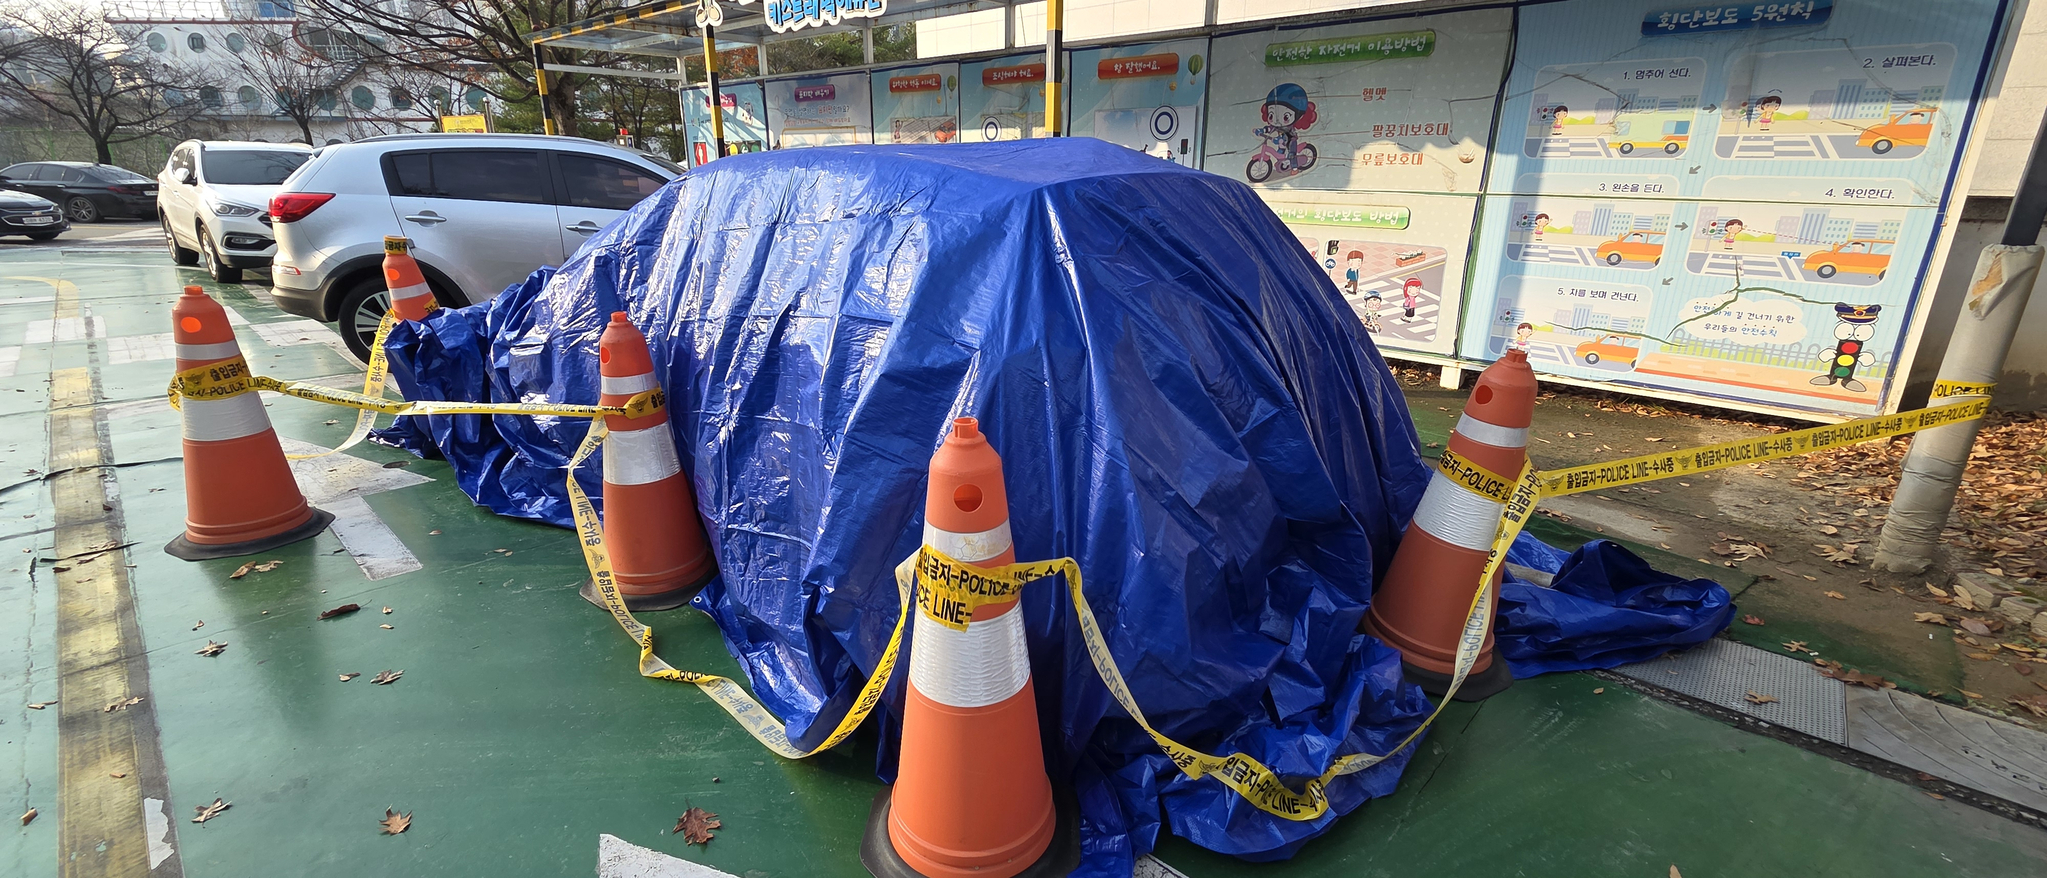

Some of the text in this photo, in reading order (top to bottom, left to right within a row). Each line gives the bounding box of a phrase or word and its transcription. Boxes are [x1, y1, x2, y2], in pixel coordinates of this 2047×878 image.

[1657, 1, 1815, 30] 횡단보도 5원칙
[1272, 35, 1427, 61] 안전한 자전거 이용방법
[1862, 55, 1936, 68] 2. 살펴본다.
[1623, 67, 1691, 80] 1. 멈추어 선다.
[1362, 87, 1387, 101] 헬멧
[1371, 123, 1449, 138] 팔꿈치보호대
[1361, 152, 1424, 167] 무릎보호대
[1599, 183, 1665, 193] 3. 왼손을 든다.
[1825, 188, 1895, 199] 4. 확인한다.
[1313, 208, 1362, 222] 횡단보도
[1369, 210, 1400, 226] 방법
[1557, 287, 1566, 296] 5.
[1569, 288, 1586, 297] 차를
[1736, 311, 1744, 320] 길
[1747, 312, 1772, 321] 건너기
[1775, 314, 1796, 324] 위한
[1703, 322, 1778, 338] 우리들의 안전수칙
[1811, 417, 1903, 447] 출입금지-POLICE LINE-수사중
[1695, 437, 1793, 468] 출입금지-POLICE LINE-수사중
[1566, 457, 1675, 490] 출입금지-POLICE LINE-수사중
